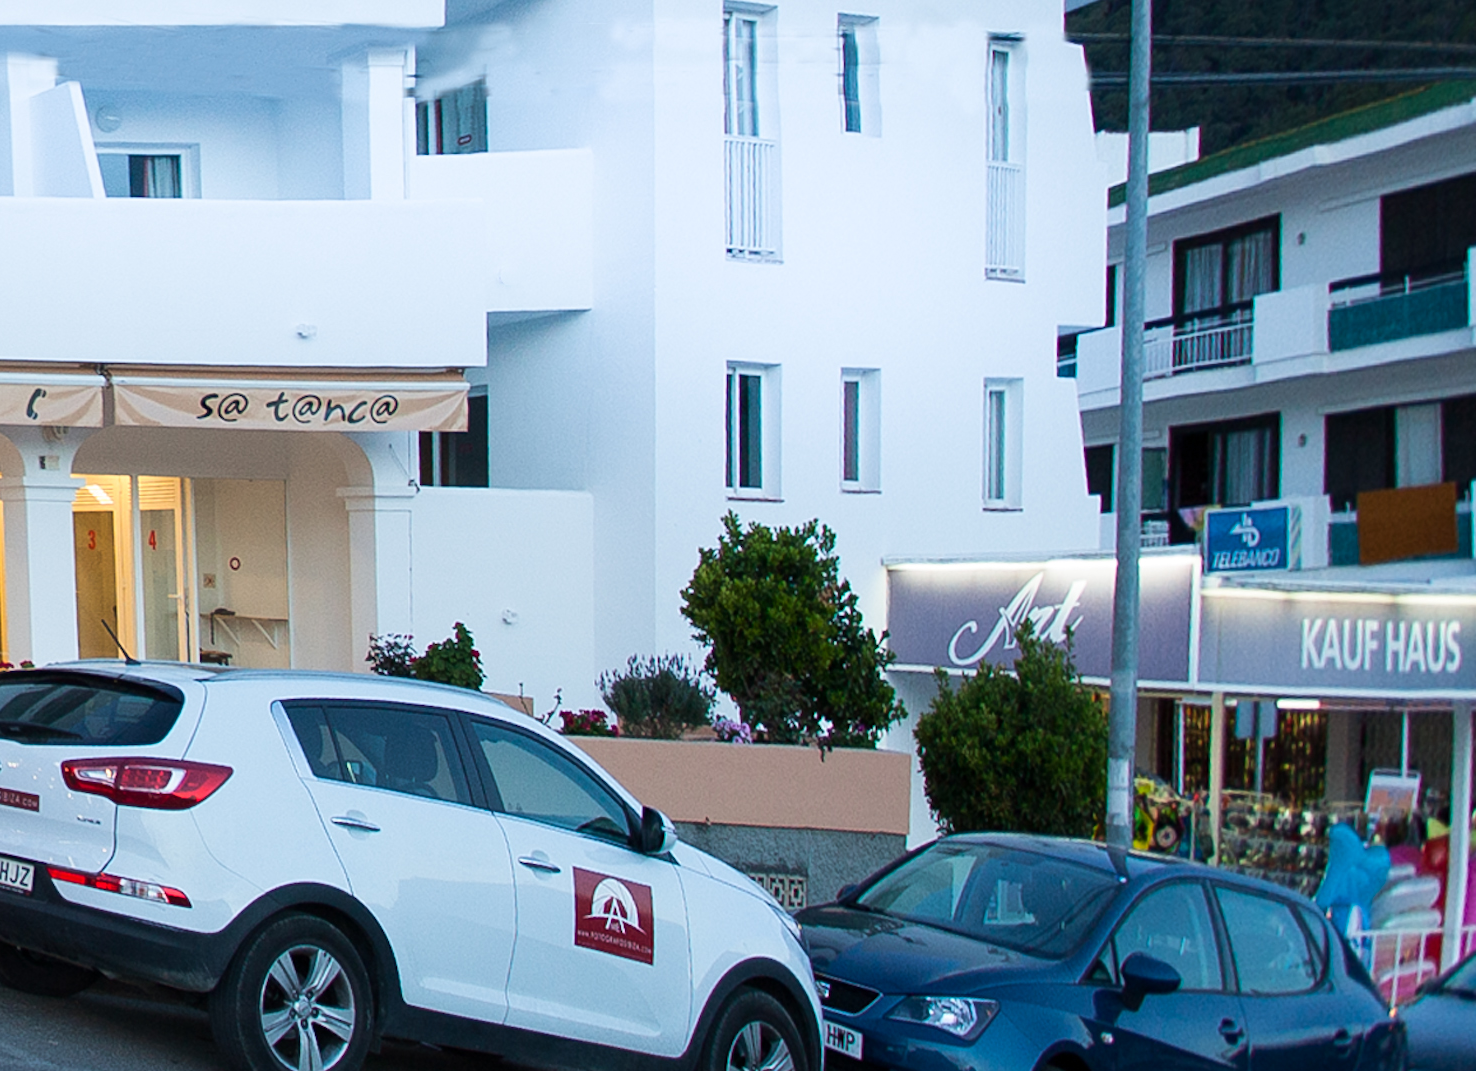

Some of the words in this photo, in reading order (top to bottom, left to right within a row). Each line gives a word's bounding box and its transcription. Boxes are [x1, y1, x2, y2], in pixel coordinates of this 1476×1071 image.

[266, 391, 399, 424] t@nc@
[87, 530, 96, 550] 3
[148, 530, 157, 550] 4
[1212, 547, 1281, 569] TELEBANCO
[948, 571, 1088, 666] Art
[1301, 618, 1380, 670] KAUF
[1386, 620, 1462, 673] HAUS
[0, 862, 31, 888] HJZ
[826, 1023, 856, 1052] HWP
